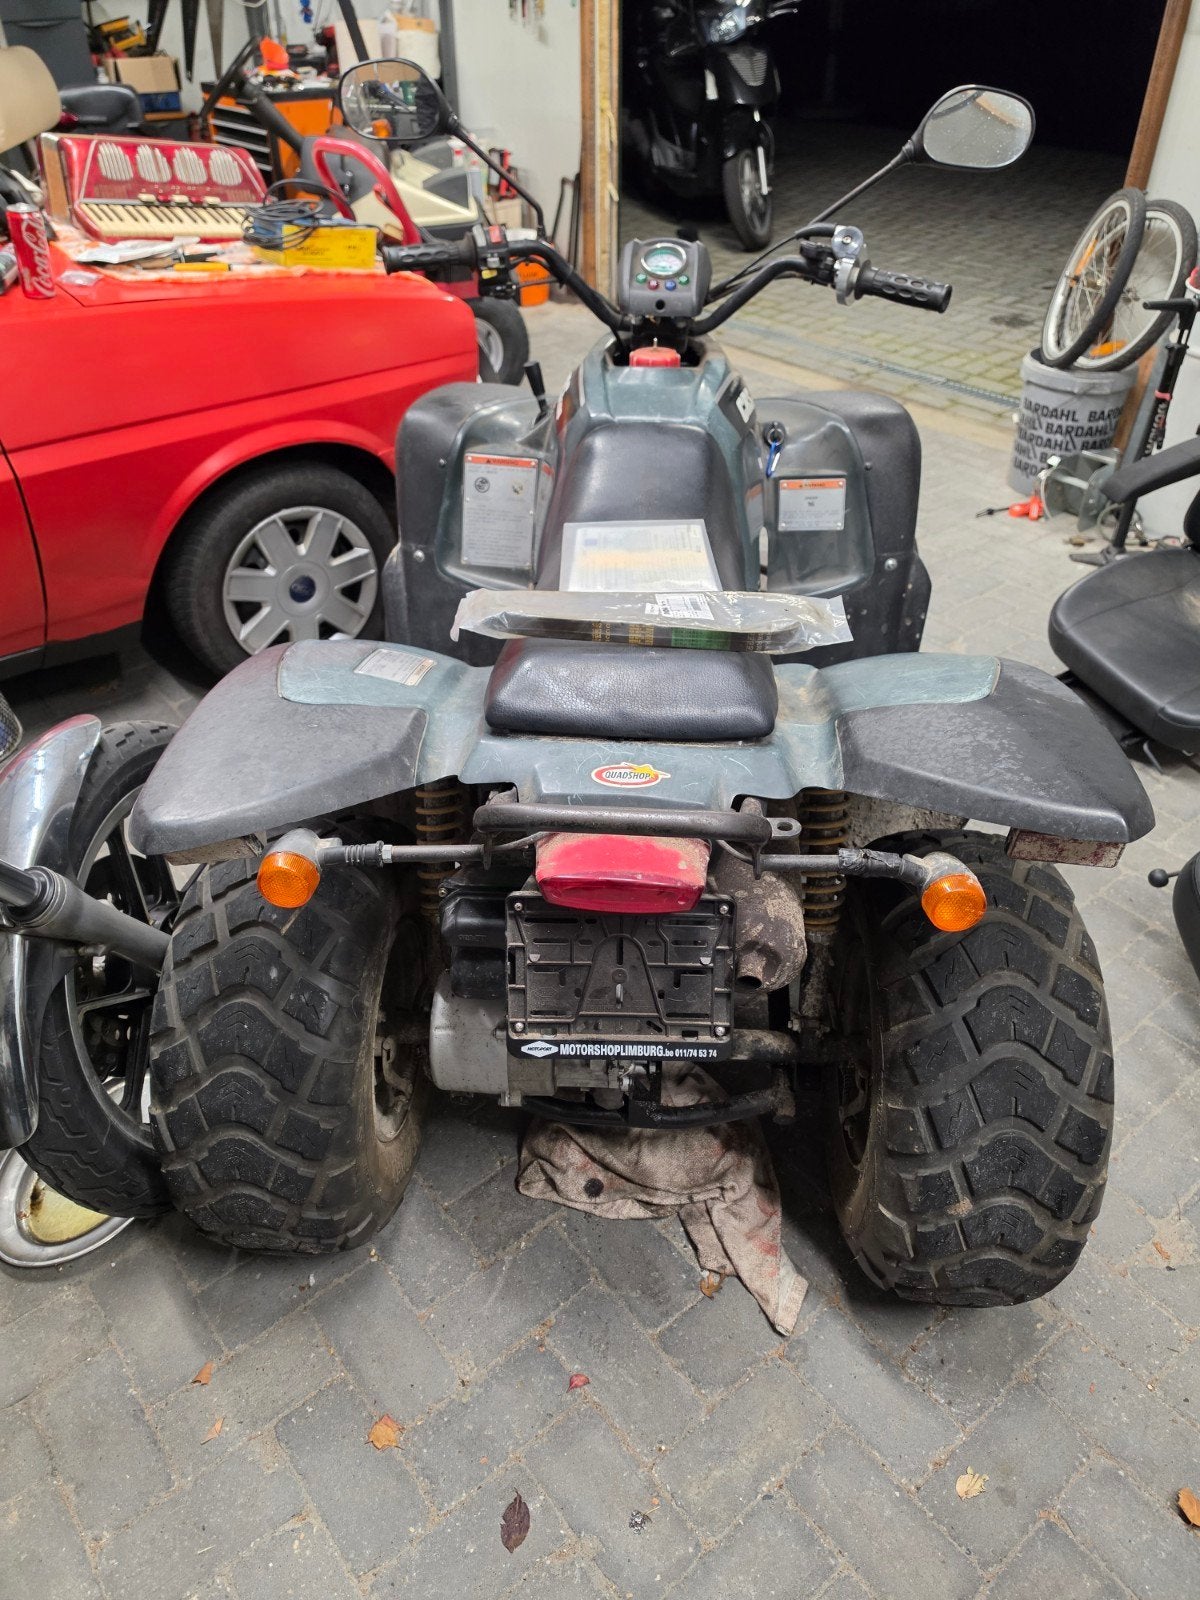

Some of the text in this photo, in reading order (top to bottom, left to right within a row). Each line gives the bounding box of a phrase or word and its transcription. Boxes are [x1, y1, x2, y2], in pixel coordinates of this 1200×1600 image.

[605, 771, 650, 779] QUADSHOP
[560, 1043, 717, 1058] MOTORSHOPLIMBURG.be 011/74 53 74
